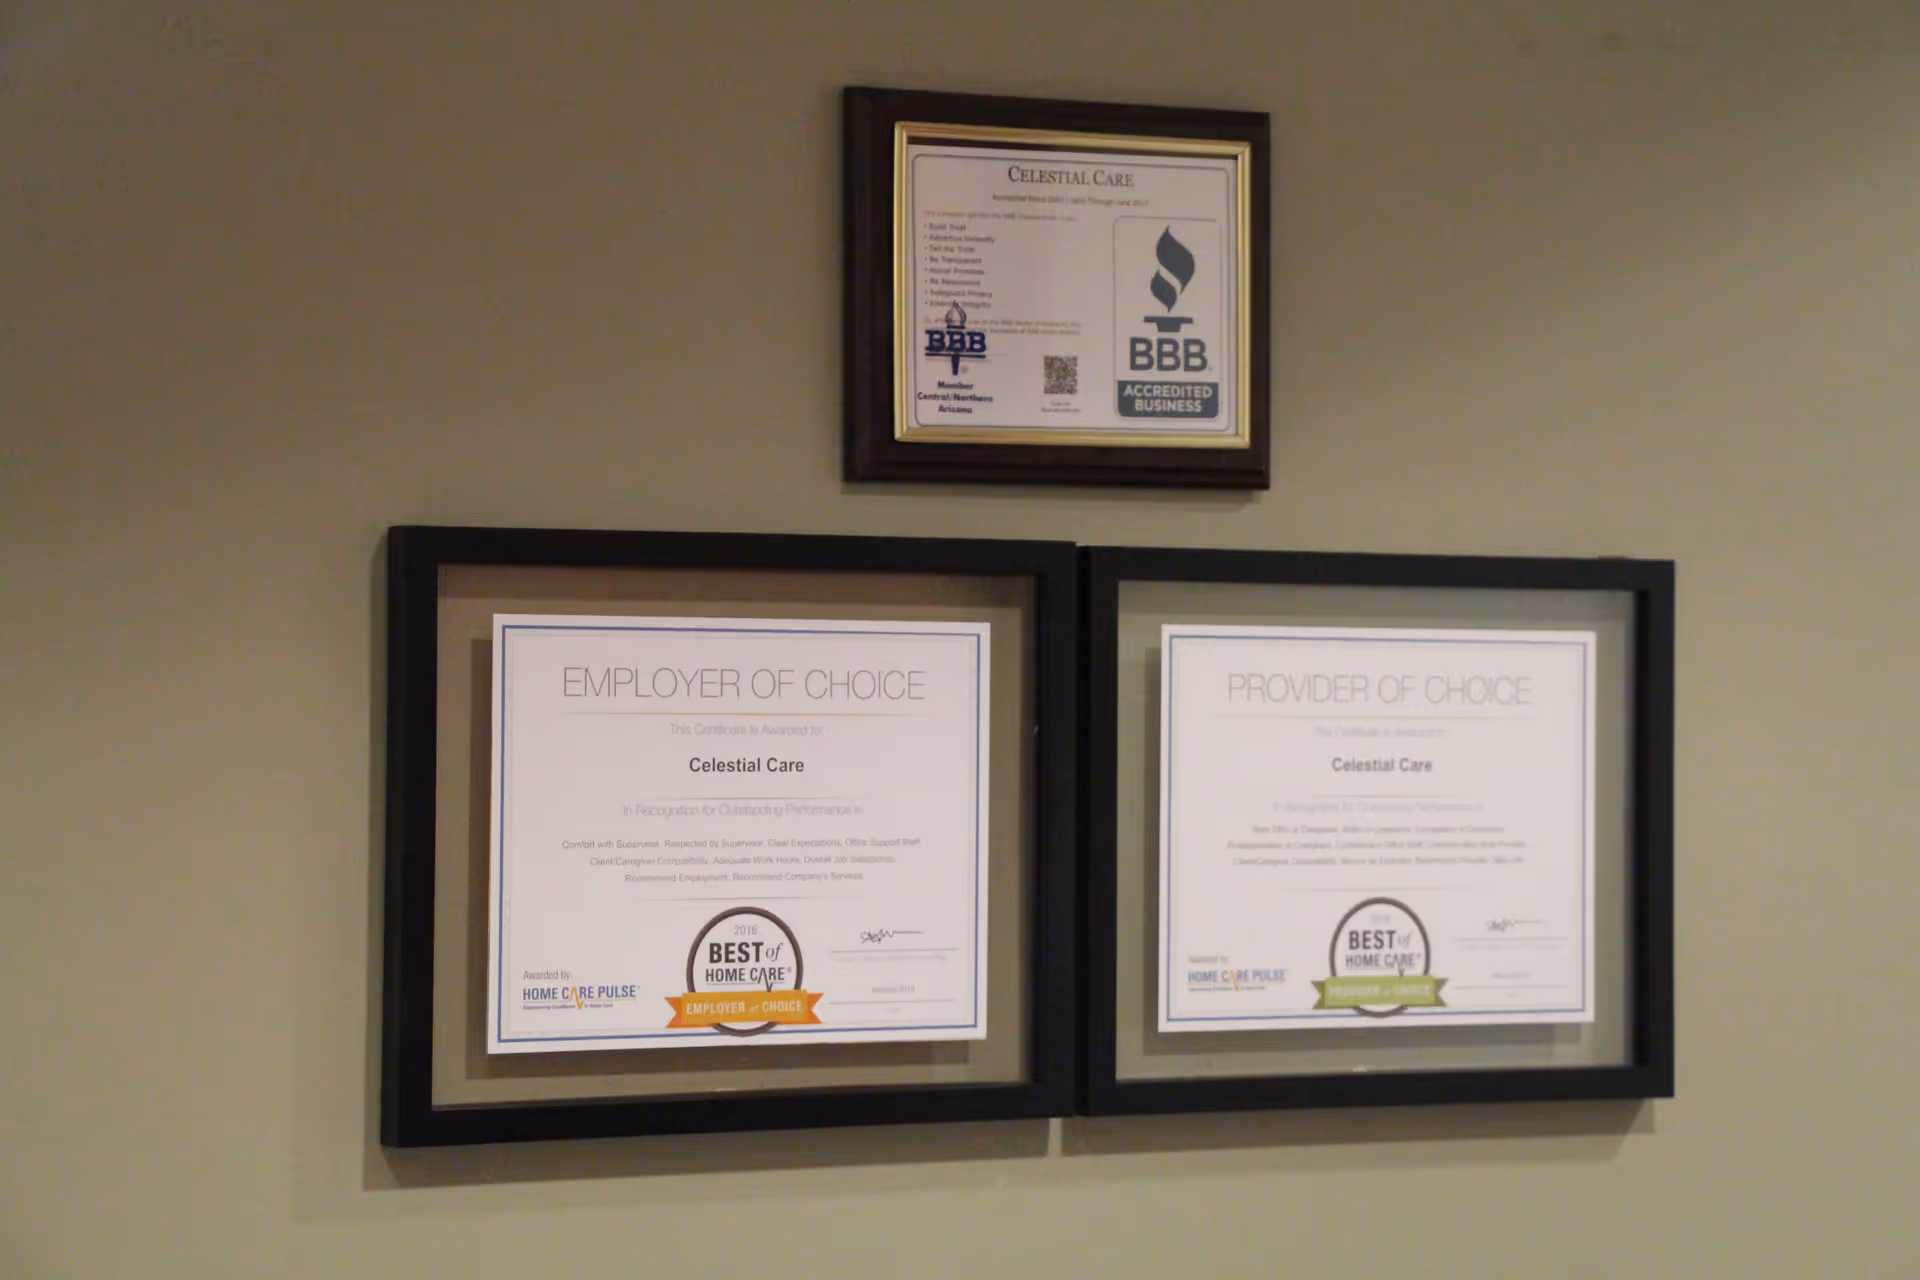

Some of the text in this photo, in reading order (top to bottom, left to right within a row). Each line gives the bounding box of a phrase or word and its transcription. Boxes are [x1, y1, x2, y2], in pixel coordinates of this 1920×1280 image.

[1007, 165, 1135, 188] CELESTIAL CARE
[924, 329, 987, 353] BBB
[1129, 336, 1209, 372] BBB
[1123, 383, 1213, 399] ACCREDITED
[1134, 398, 1203, 413] BUSINESS
[561, 666, 926, 701] EMPLOYER OF CHOICE
[1227, 672, 1533, 705] PROVIDER OF CHOICE
[688, 756, 805, 773] Celestial Care
[1331, 756, 1433, 773] Celestial Care
[1348, 929, 1398, 950] BEST
[708, 941, 785, 964] BEST of
[1344, 954, 1381, 967] HOME
[523, 969, 559, 980] Awarded
[705, 967, 786, 986] HOME CARE
[522, 984, 637, 1002] HOME CARE PULSE
[686, 1000, 746, 1016] EMPLOYER
[761, 1000, 803, 1014] CHOICE
